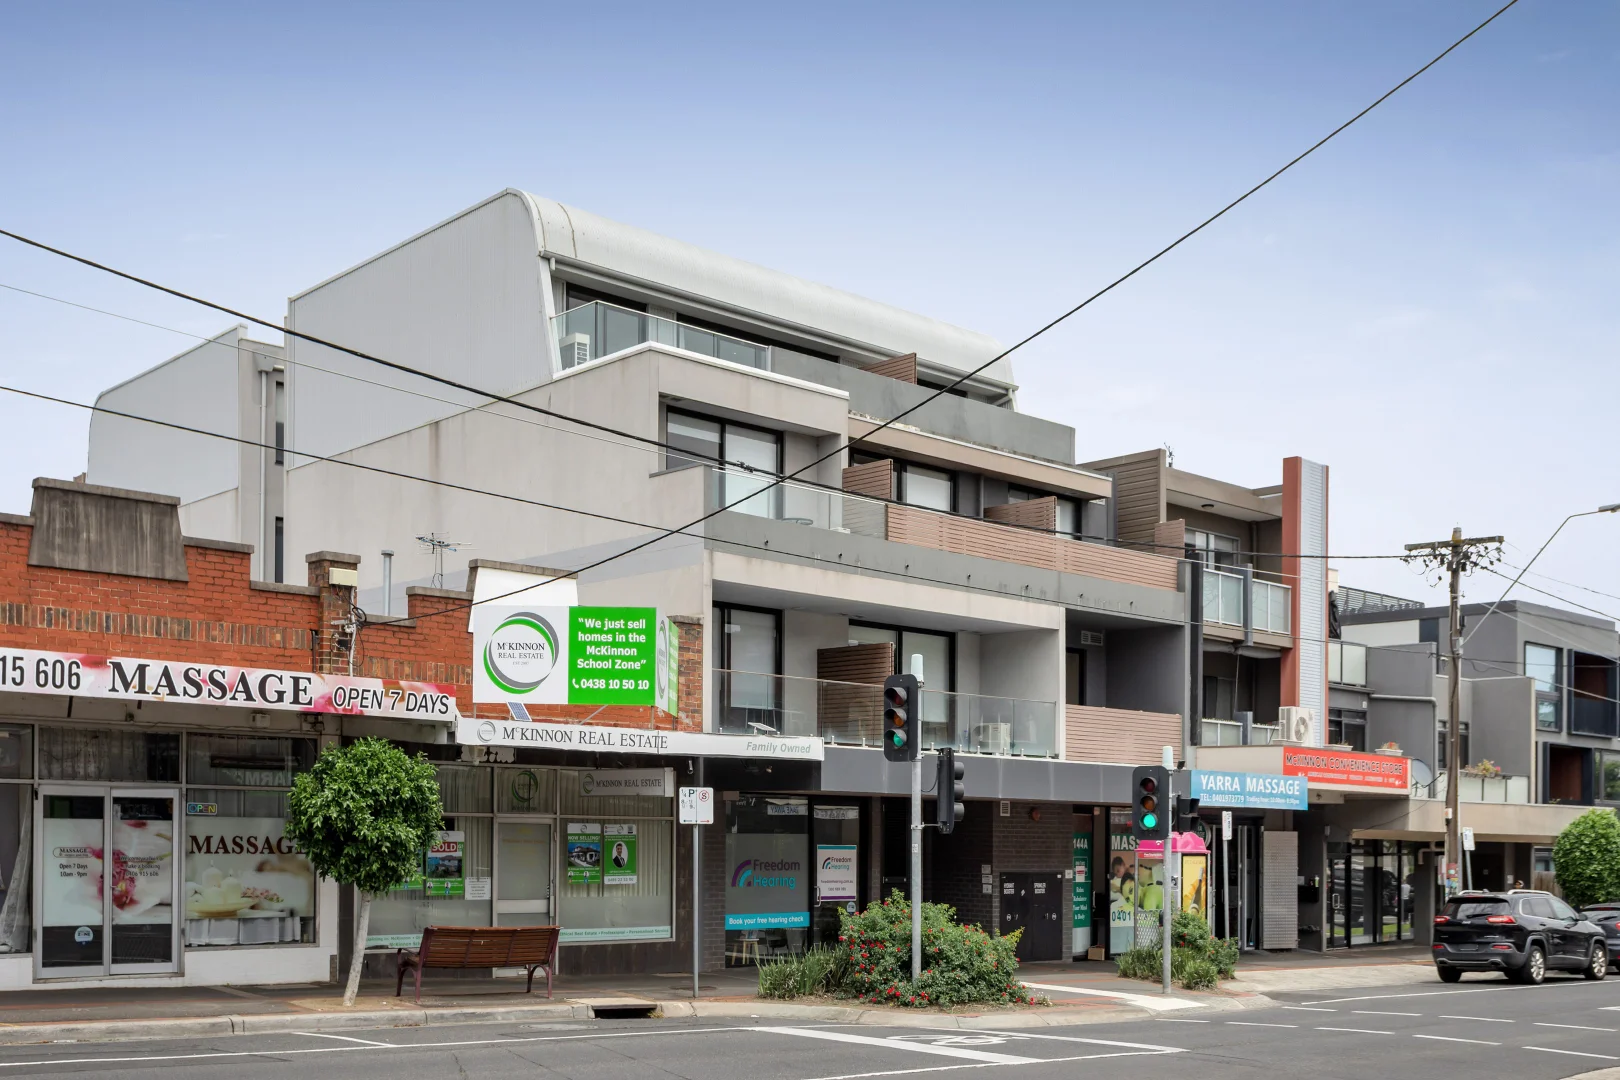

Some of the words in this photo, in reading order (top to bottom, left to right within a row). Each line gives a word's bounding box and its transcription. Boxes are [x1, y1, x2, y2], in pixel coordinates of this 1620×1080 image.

[604, 618, 625, 630] just
[627, 618, 646, 629] sell
[578, 632, 613, 642] homes
[615, 632, 626, 642] in
[628, 633, 646, 643] the
[497, 642, 545, 651] McKINNON
[586, 646, 638, 656] McKinnon
[577, 659, 612, 669] School
[35, 657, 81, 690] 606
[108, 660, 313, 706] MASSAGE
[580, 679, 606, 689] 0438
[608, 680, 620, 689] 10
[622, 680, 635, 689] 50
[637, 680, 650, 690] 10
[333, 686, 384, 709] OPEN
[390, 691, 401, 711] 7
[405, 692, 450, 714] DAYS
[502, 726, 573, 743] McKINNON
[578, 730, 616, 746] REAL
[619, 733, 668, 749] ESTATE
[746, 741, 778, 754] Family
[780, 743, 811, 754] Owned
[1329, 757, 1380, 773] CONVENIENCE
[1381, 762, 1403, 774] STORE
[624, 779, 640, 788] REAL
[640, 778, 662, 788] ESTATE
[1200, 774, 1241, 791] YARRA
[1246, 776, 1300, 795] MASSAGE
[1200, 793, 1212, 802] TEL:
[188, 804, 217, 814] OPEN
[432, 843, 457, 851] SOLD
[1073, 838, 1088, 849] 144A
[753, 860, 800, 872] Freedom
[753, 874, 796, 890] Hearing
[744, 918, 756, 926] your
[768, 916, 788, 925] hearing
[1111, 910, 1132, 922] 0401
